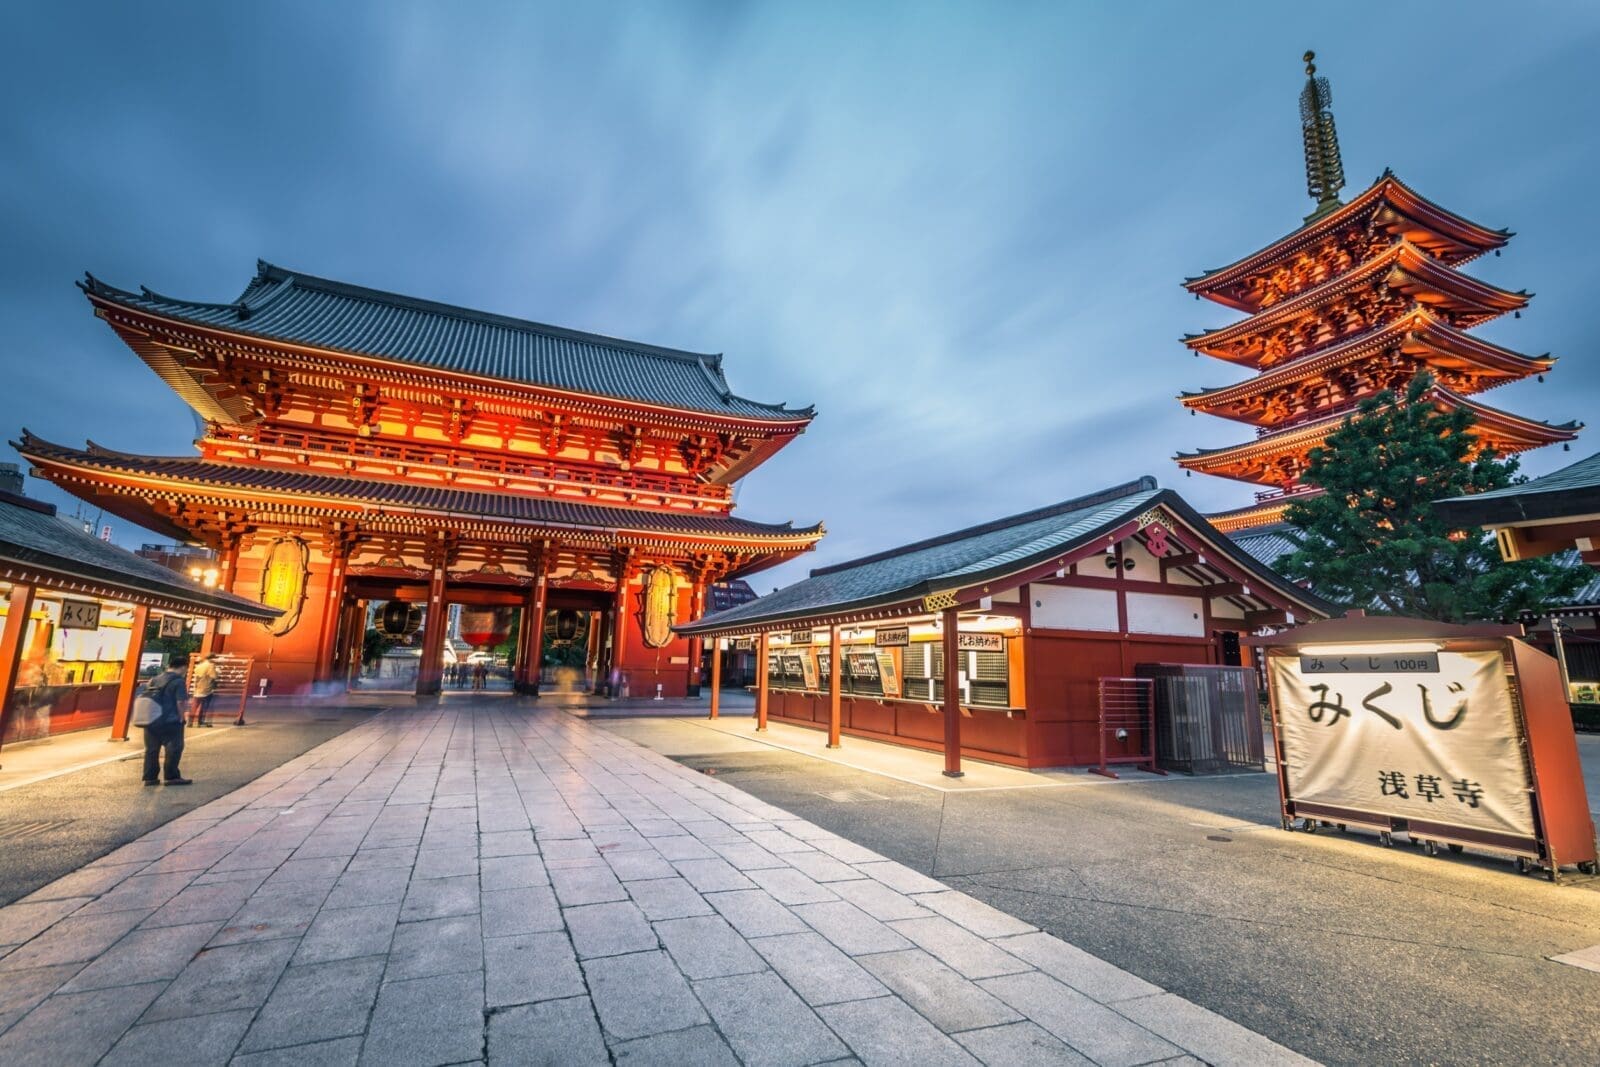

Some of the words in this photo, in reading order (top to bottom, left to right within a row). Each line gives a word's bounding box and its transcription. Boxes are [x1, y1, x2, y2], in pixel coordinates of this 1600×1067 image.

[64, 605, 96, 625] みくじ
[1310, 656, 1381, 671] みくじ
[1393, 660, 1428, 670] 100円
[1308, 681, 1468, 730] みくじ
[1378, 770, 1484, 808] 浅草寺
